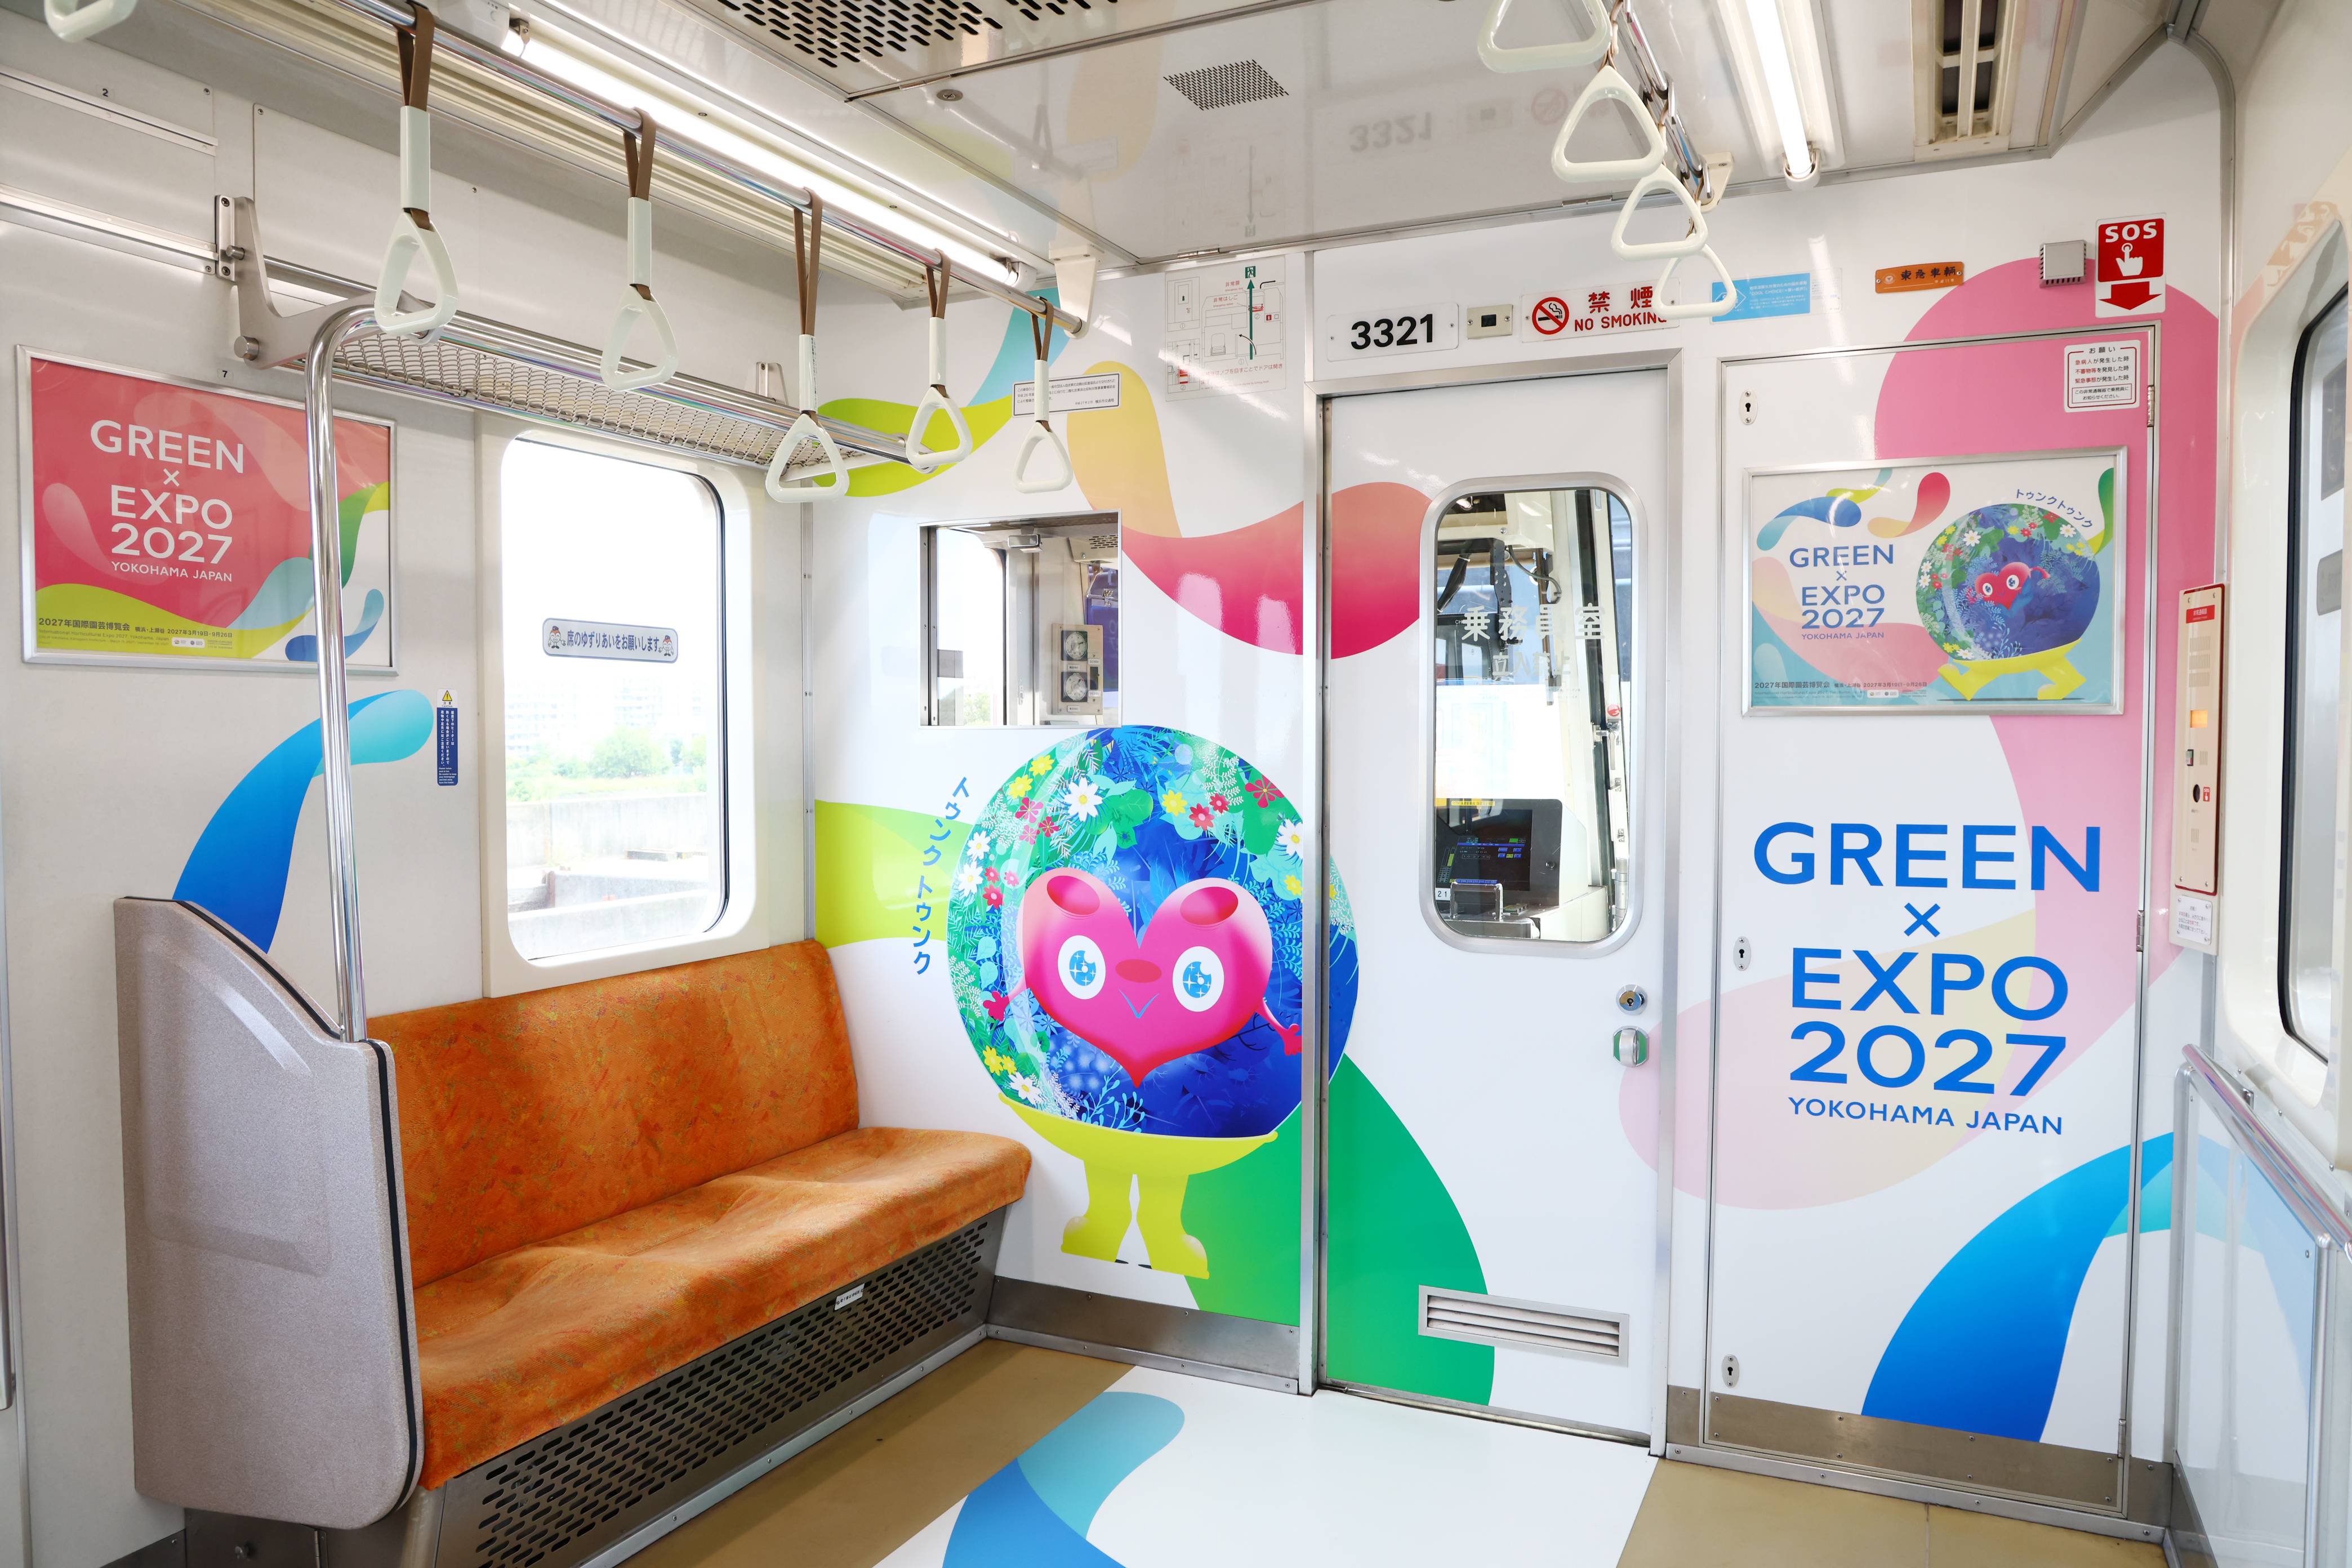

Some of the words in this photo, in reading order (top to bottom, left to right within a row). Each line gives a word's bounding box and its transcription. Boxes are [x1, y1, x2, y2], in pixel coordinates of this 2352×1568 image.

[103, 88, 109, 97] 2
[2105, 222, 2157, 243] SOS
[1351, 314, 1433, 350] 3321
[1575, 318, 1593, 332] NO
[91, 420, 243, 474] GREEN
[112, 484, 233, 529] EXPO
[112, 523, 233, 564] 2027
[1790, 544, 1894, 568] GREEN
[111, 561, 189, 578] YOKOHAMA
[193, 570, 232, 582] JAPAN
[1802, 584, 1885, 606] EXPO
[1802, 608, 1885, 629] 2027
[567, 630, 660, 652] 席のゆずりあいをお願いします
[1754, 822, 2101, 892] GREEN
[1792, 947, 2068, 1021] EXPO
[1790, 1021, 2066, 1097] 2027
[1788, 1097, 1955, 1127] YOKOHAMA
[1966, 1111, 2063, 1135] JAPAN
